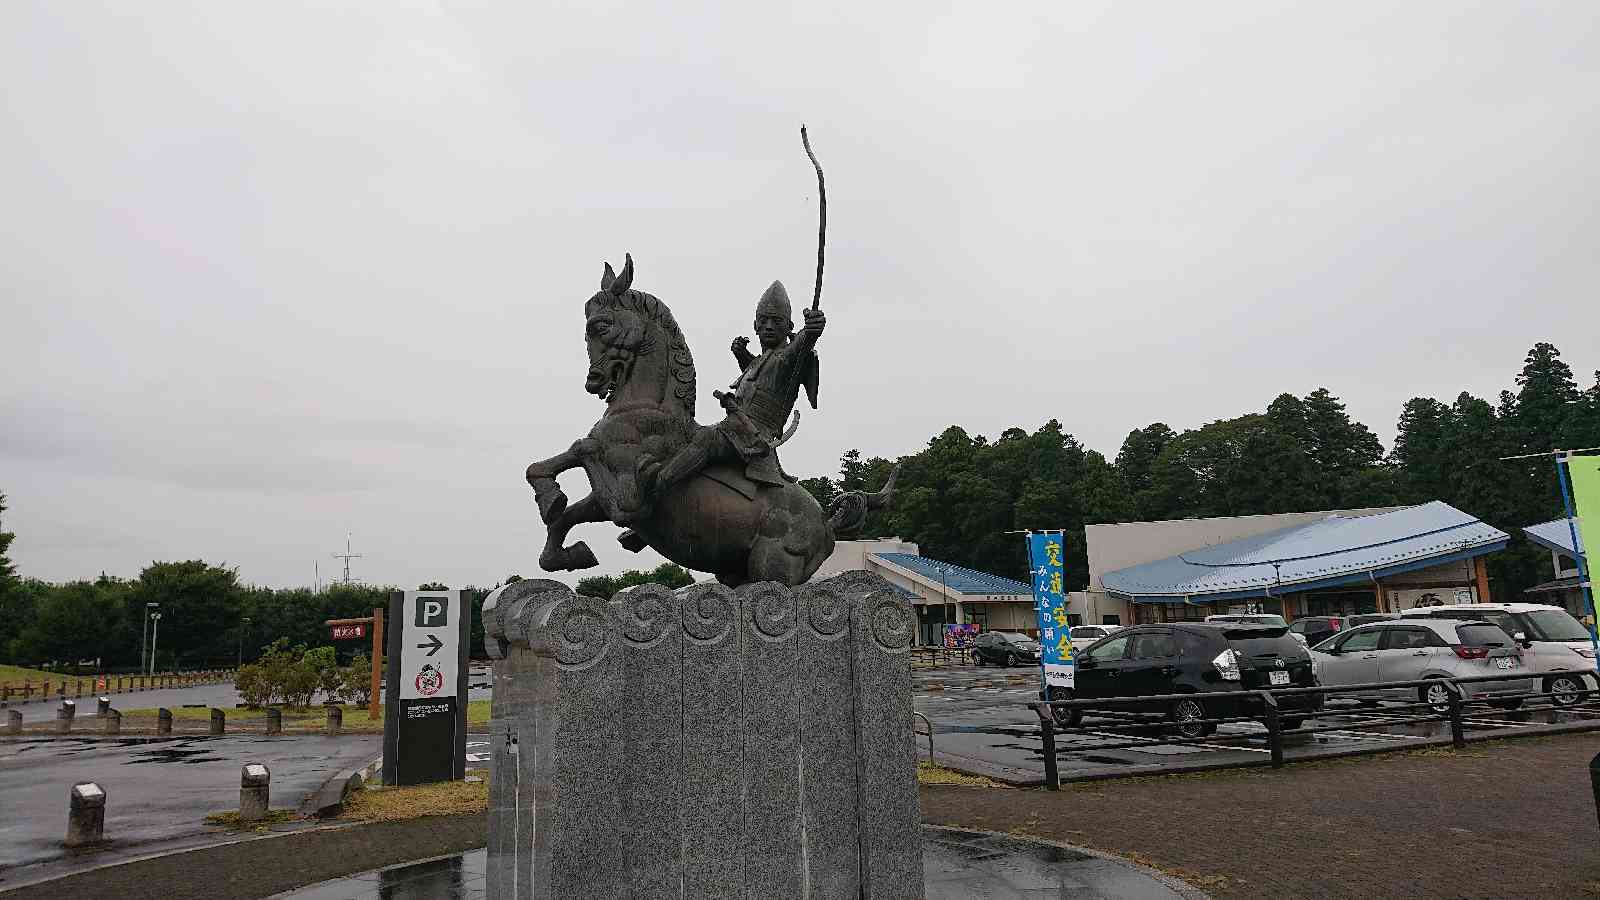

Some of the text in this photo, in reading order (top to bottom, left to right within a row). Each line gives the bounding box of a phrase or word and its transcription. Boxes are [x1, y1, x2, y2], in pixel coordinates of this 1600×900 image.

[423, 601, 442, 625] P
[1037, 566, 1055, 654] みんなの願い
[1045, 541, 1073, 661] 交通安全
